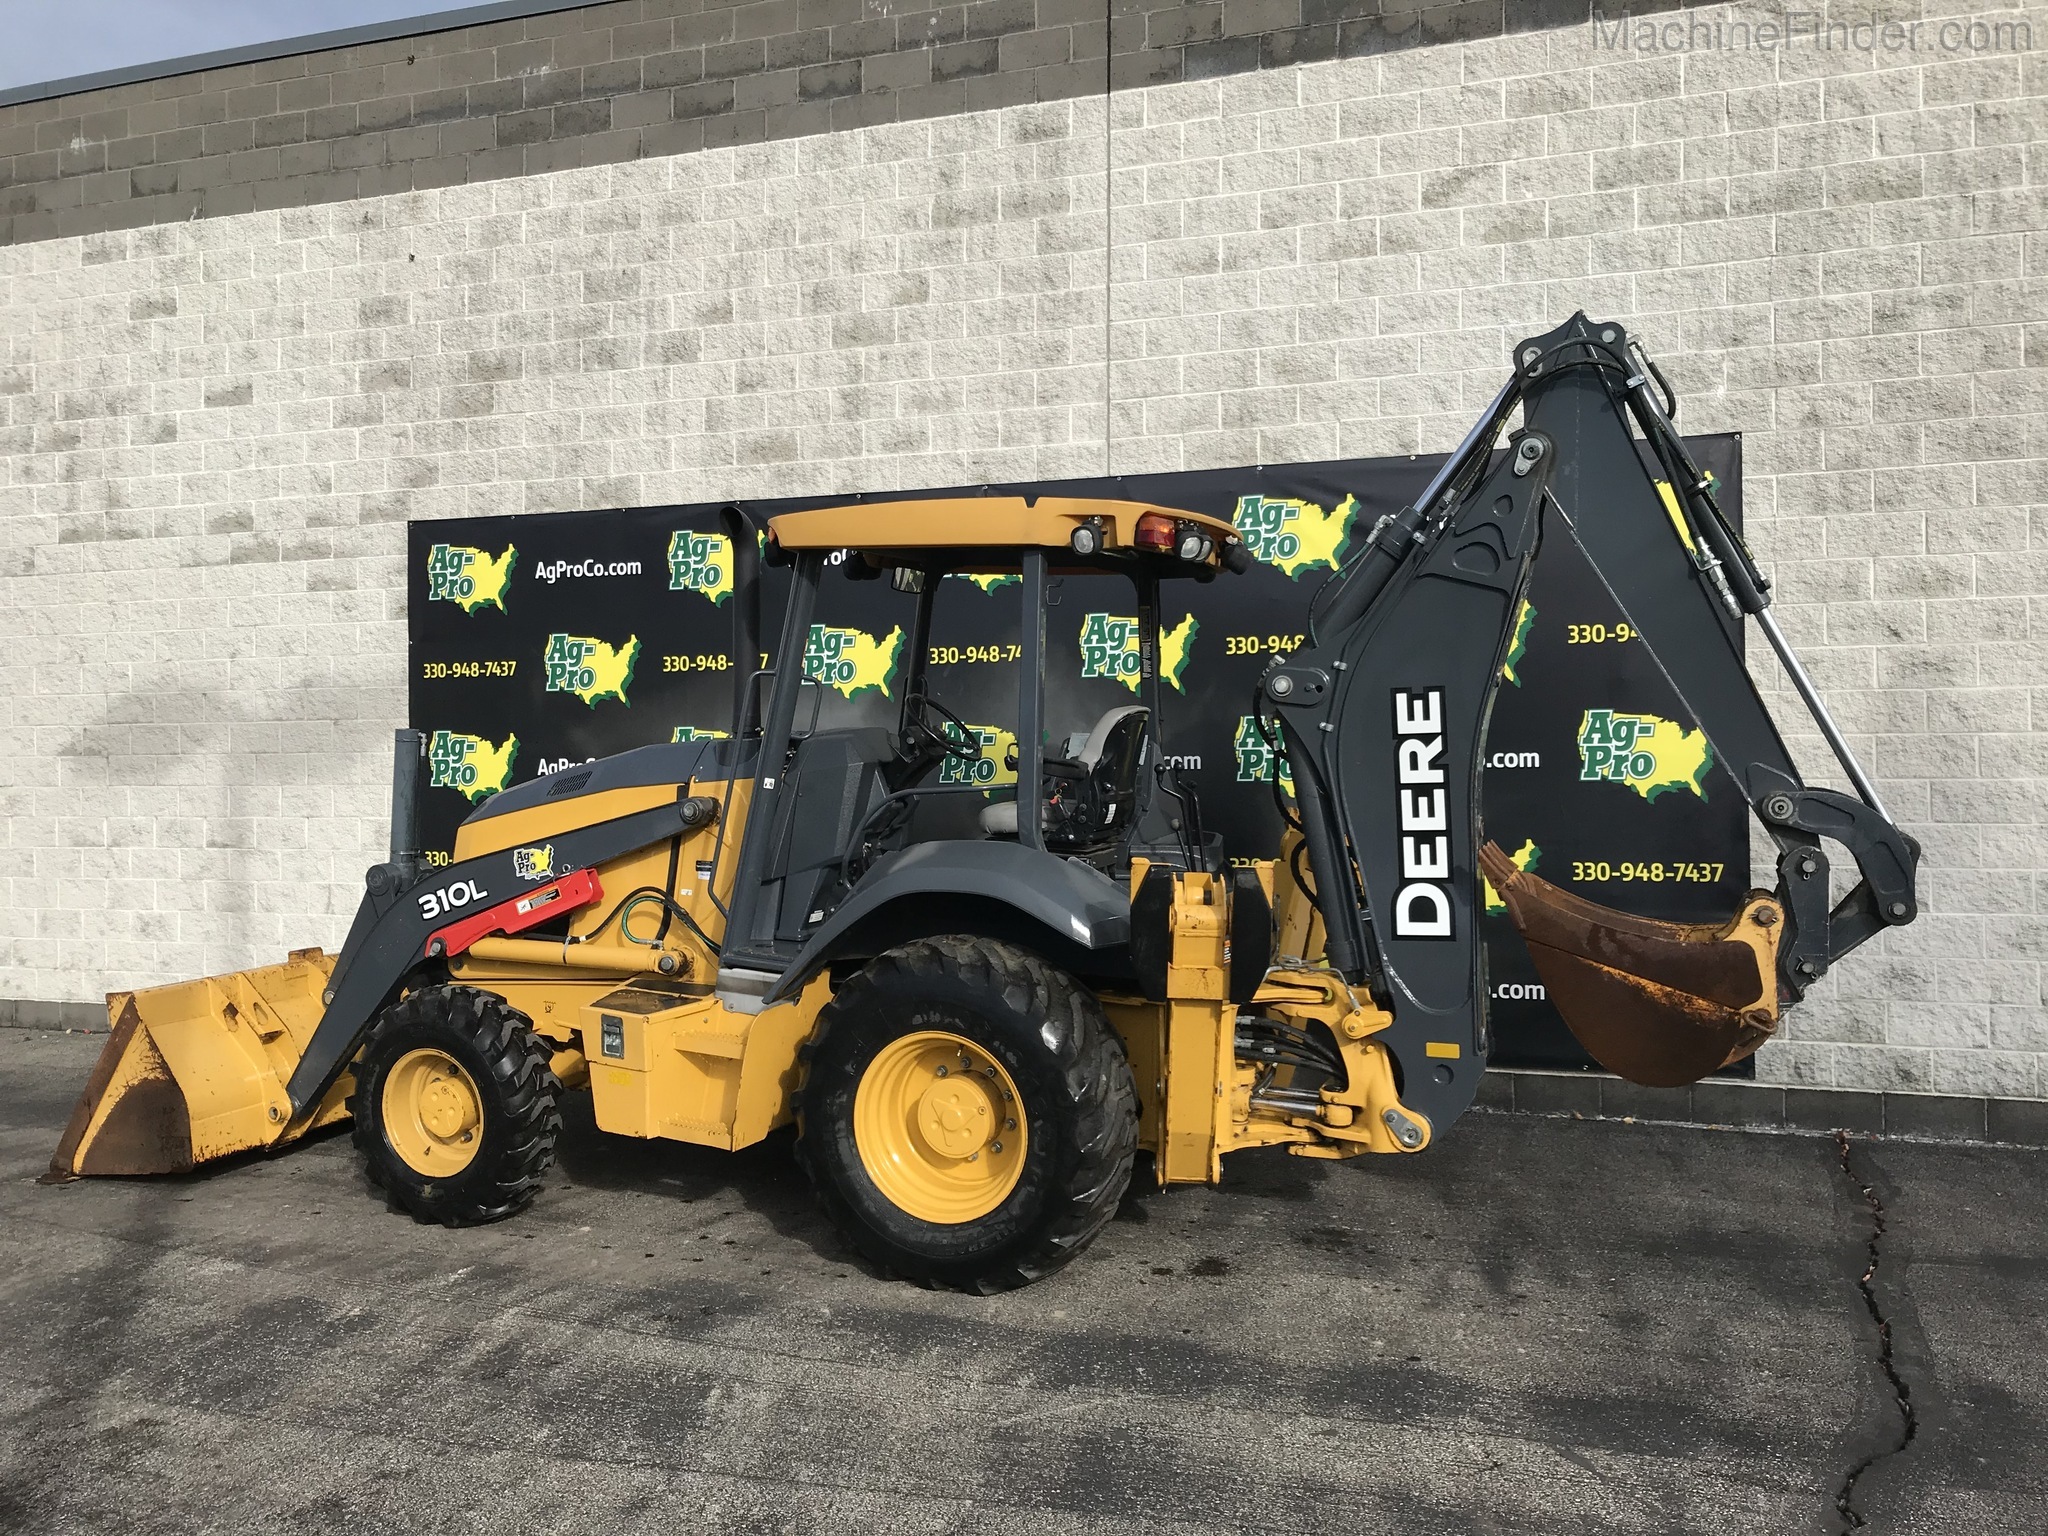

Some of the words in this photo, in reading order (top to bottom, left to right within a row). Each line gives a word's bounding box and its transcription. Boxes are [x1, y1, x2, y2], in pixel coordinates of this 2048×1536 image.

[1234, 495, 1300, 534] Ag-
[430, 544, 475, 577] Ag-
[671, 530, 722, 565] Ag-
[1239, 529, 1300, 561] Pro
[429, 572, 476, 601] Pro
[535, 559, 642, 584] AgProCo.com
[669, 561, 722, 590] Pro
[805, 624, 856, 659] Ag-
[1082, 612, 1140, 651] Ag-
[546, 633, 596, 667] Ag-
[1081, 645, 1141, 677] Pro
[423, 661, 517, 678] 330-948-7437
[545, 662, 597, 691] Pro
[802, 655, 856, 685] Pro
[431, 730, 477, 760] Ag-
[1580, 709, 1655, 751] Ag-
[430, 758, 477, 787] Pro
[939, 755, 996, 783] Pro
[1579, 745, 1656, 781] Pro
[1395, 691, 1451, 936] DEERE
[516, 851, 534, 863] Ag-
[517, 862, 536, 873] Pro
[1572, 862, 1725, 882] 330-948-7437
[417, 879, 489, 920] 310L
